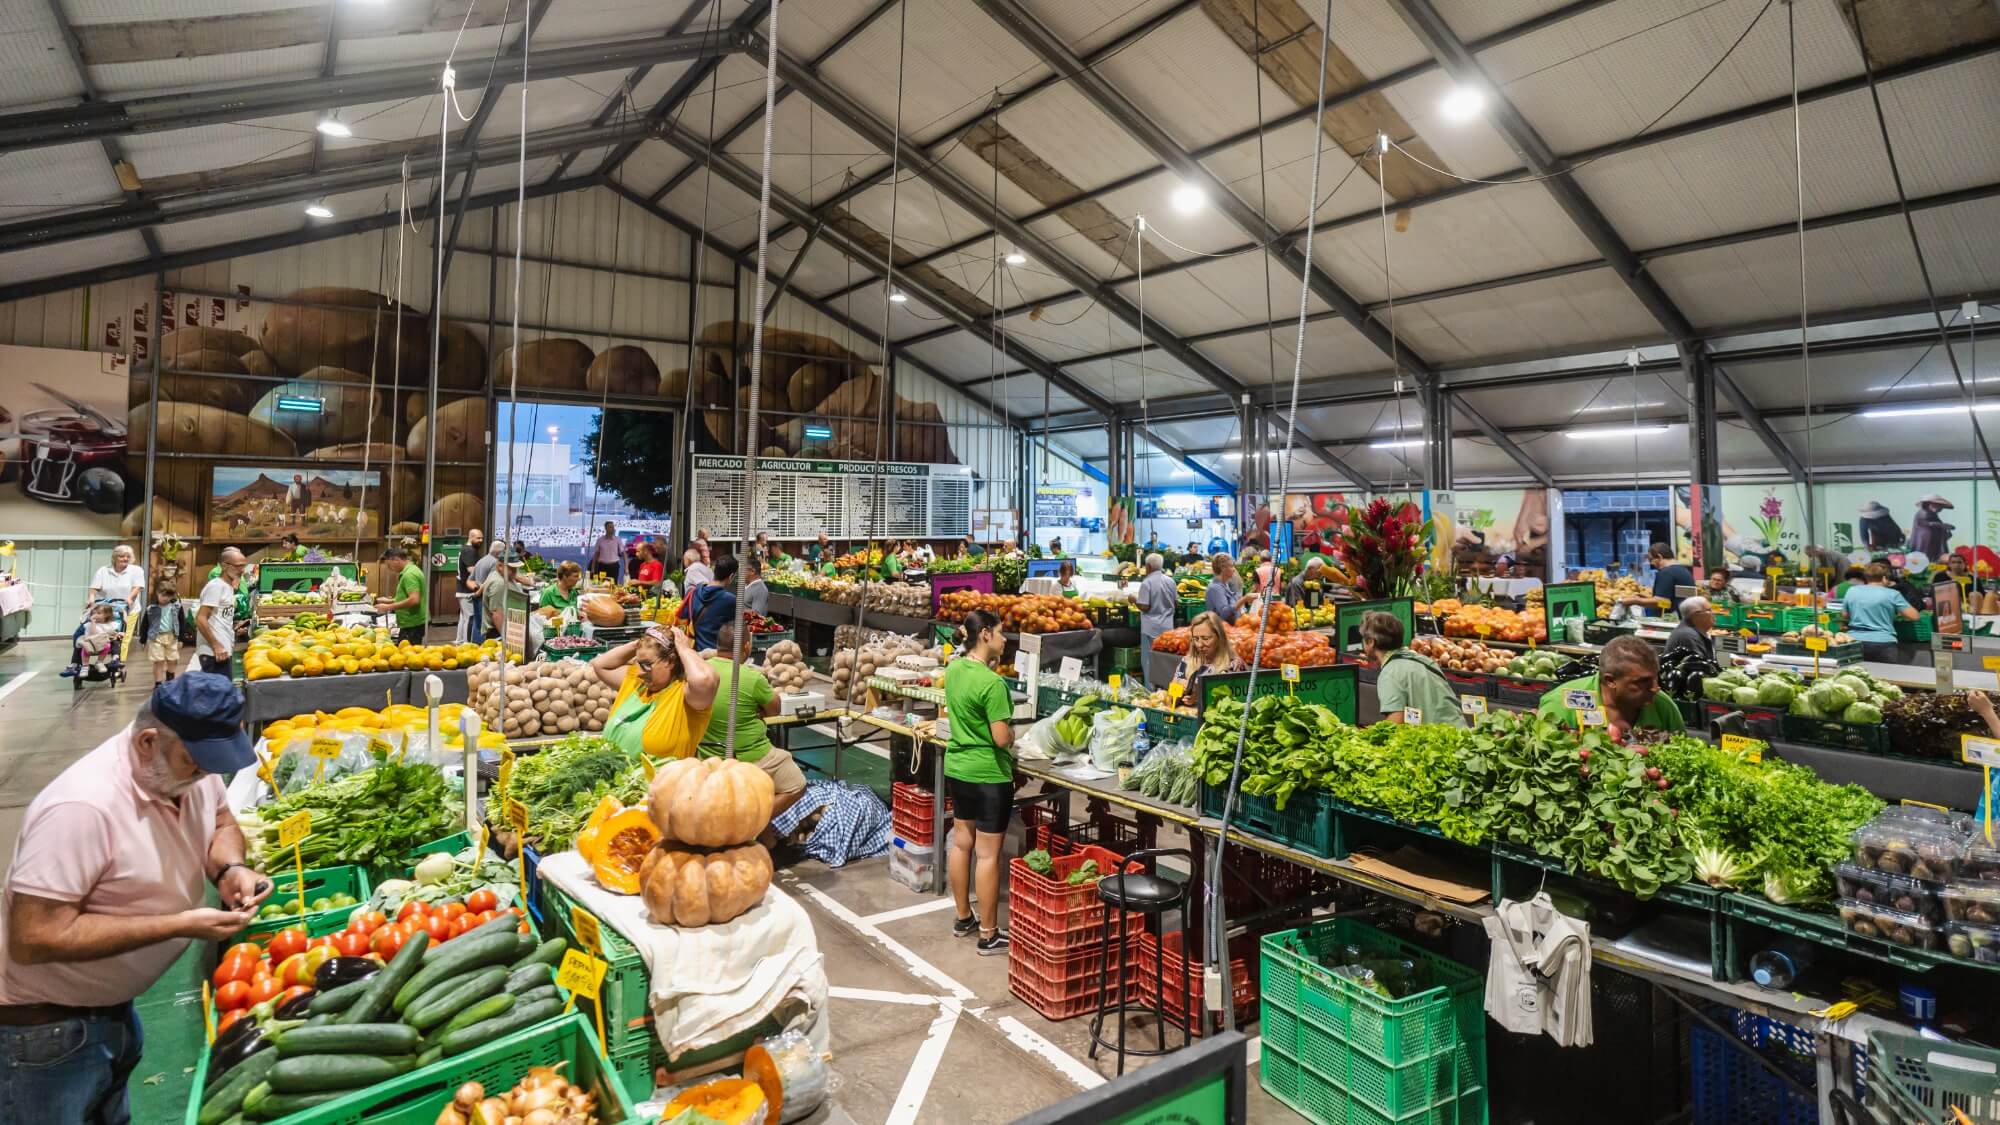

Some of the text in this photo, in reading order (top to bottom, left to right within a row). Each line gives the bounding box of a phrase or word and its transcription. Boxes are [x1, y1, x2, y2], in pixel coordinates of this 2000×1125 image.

[698, 458, 743, 469] MERCADO
[761, 461, 811, 470] AGRICULTOR
[838, 463, 885, 473] PRODUCTOS
[886, 465, 918, 474] FRESCOS
